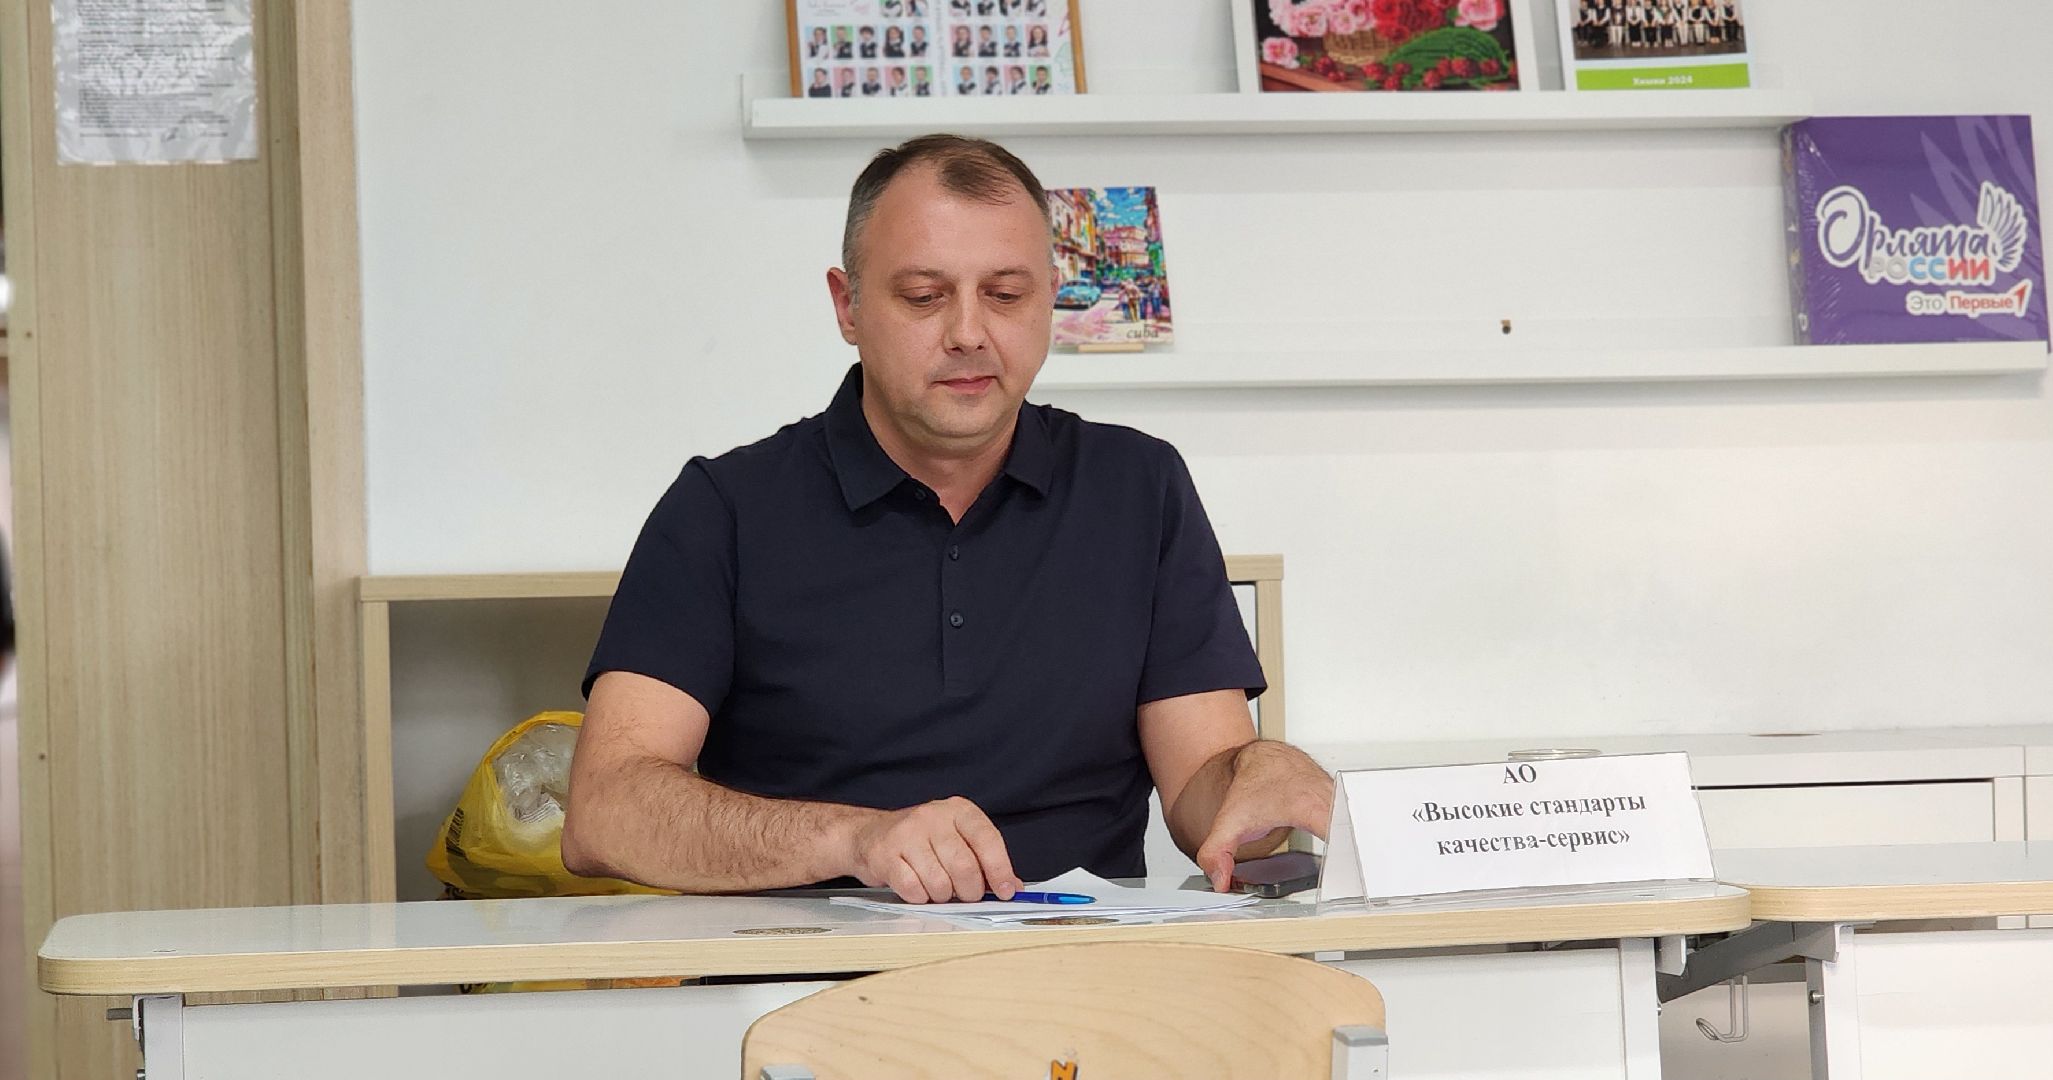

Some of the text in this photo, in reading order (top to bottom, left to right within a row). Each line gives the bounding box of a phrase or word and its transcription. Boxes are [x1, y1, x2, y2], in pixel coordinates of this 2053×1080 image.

[1668, 75, 1693, 84] 2024
[1820, 189, 1990, 271] Орлята
[1868, 256, 1990, 281] РОССИИ
[1909, 295, 1943, 311] Это
[1502, 763, 1538, 785] АО
[1412, 793, 1646, 824] «Высокие стандарты
[1436, 828, 1631, 856] качества-сервис»
